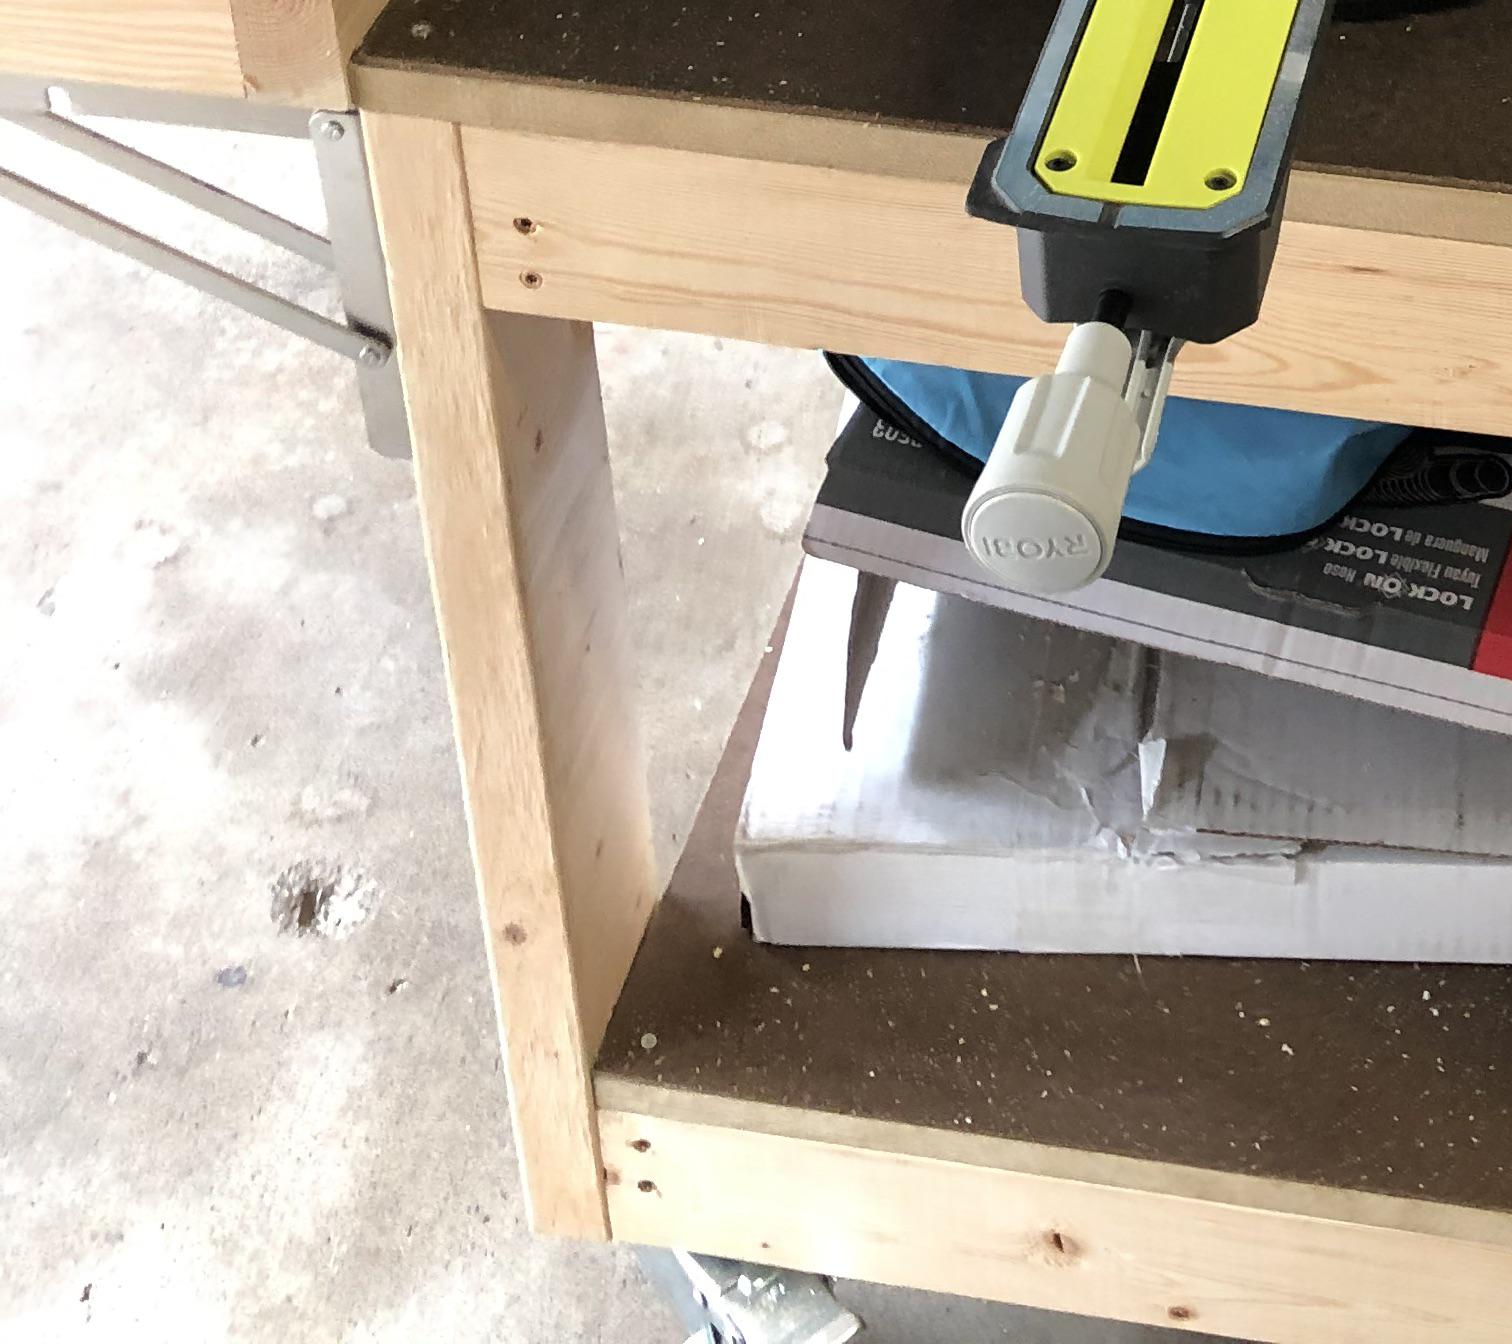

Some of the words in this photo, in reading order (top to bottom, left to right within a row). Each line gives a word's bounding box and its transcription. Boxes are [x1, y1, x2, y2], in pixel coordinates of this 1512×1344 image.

[1339, 515, 1404, 541] LOCK
[1404, 529, 1422, 545] de
[982, 535, 1087, 559] RYOBI
[1324, 537, 1389, 564] LOCK
[1323, 563, 1357, 583] Hose
[1363, 573, 1401, 594] ON
[1408, 583, 1474, 610] LOCK
